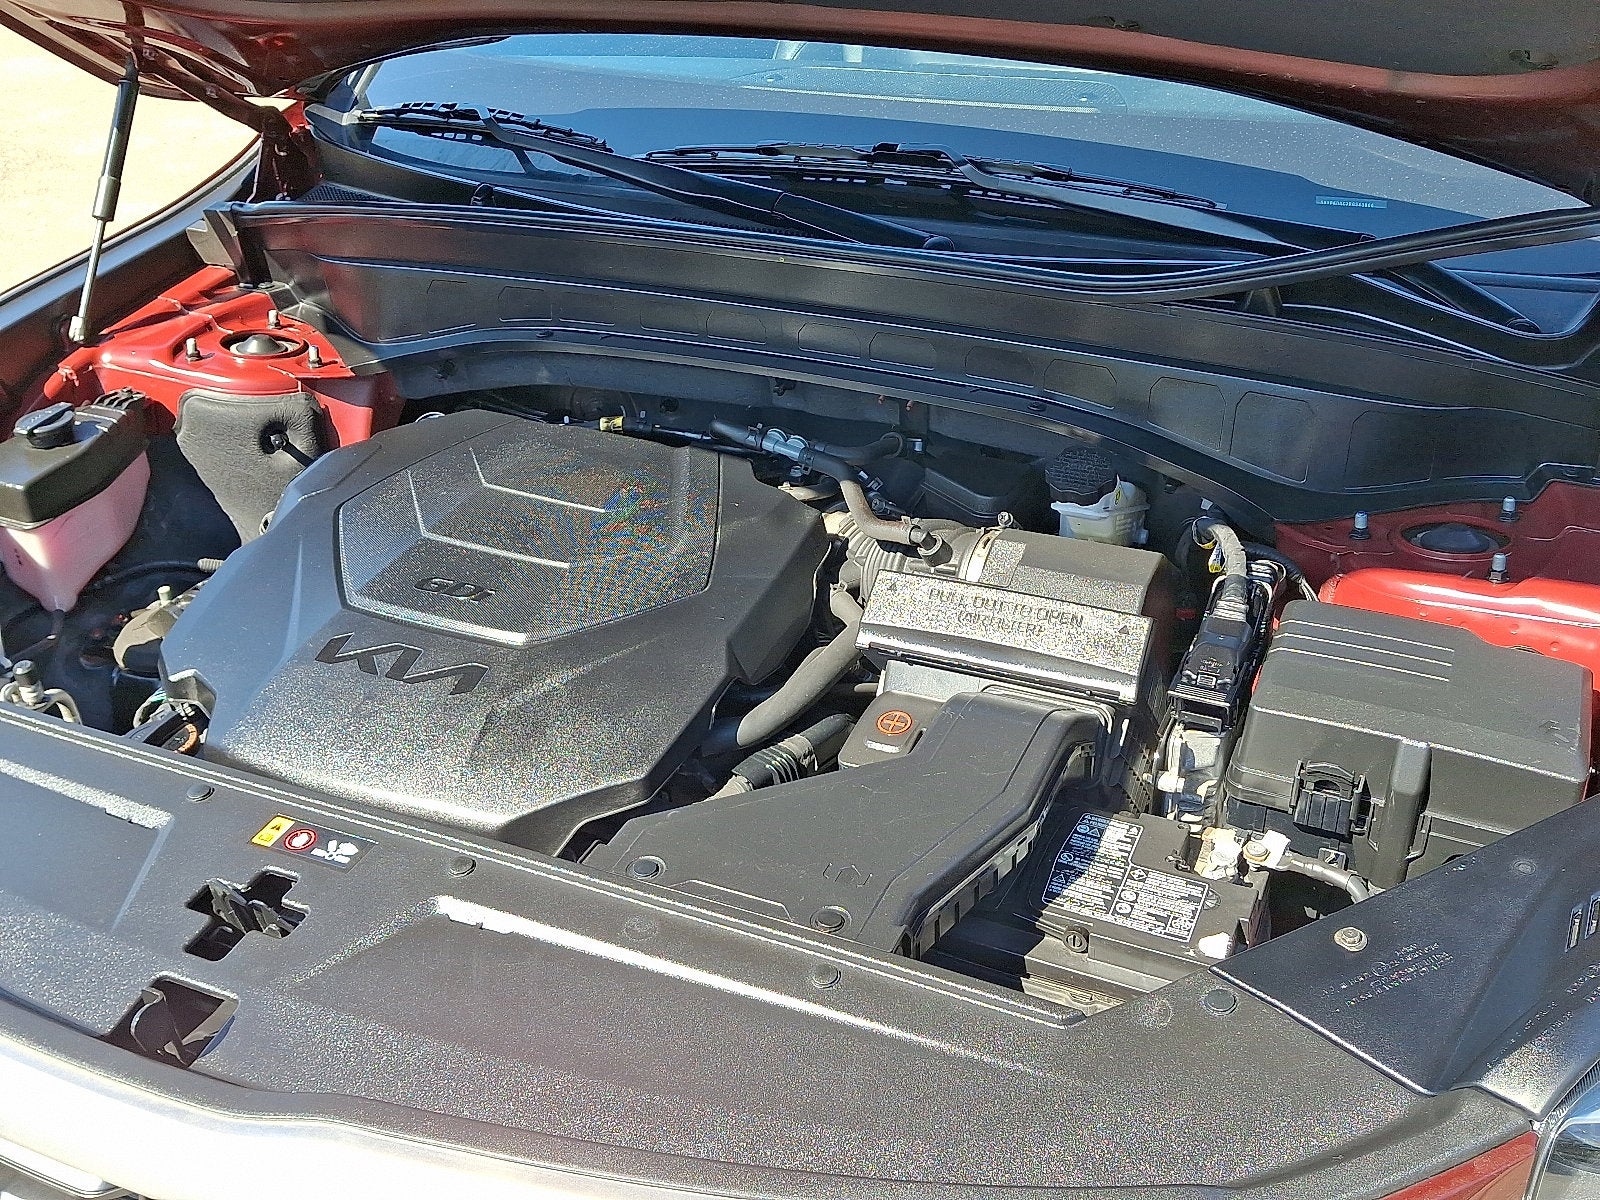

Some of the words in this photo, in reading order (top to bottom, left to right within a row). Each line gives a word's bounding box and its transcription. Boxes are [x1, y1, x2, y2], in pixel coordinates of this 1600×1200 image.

[929, 588, 969, 607] PULL
[973, 595, 1006, 614] OUT
[1010, 602, 1033, 618] TO
[1037, 606, 1084, 628] OPEN
[315, 632, 489, 695] KIA
